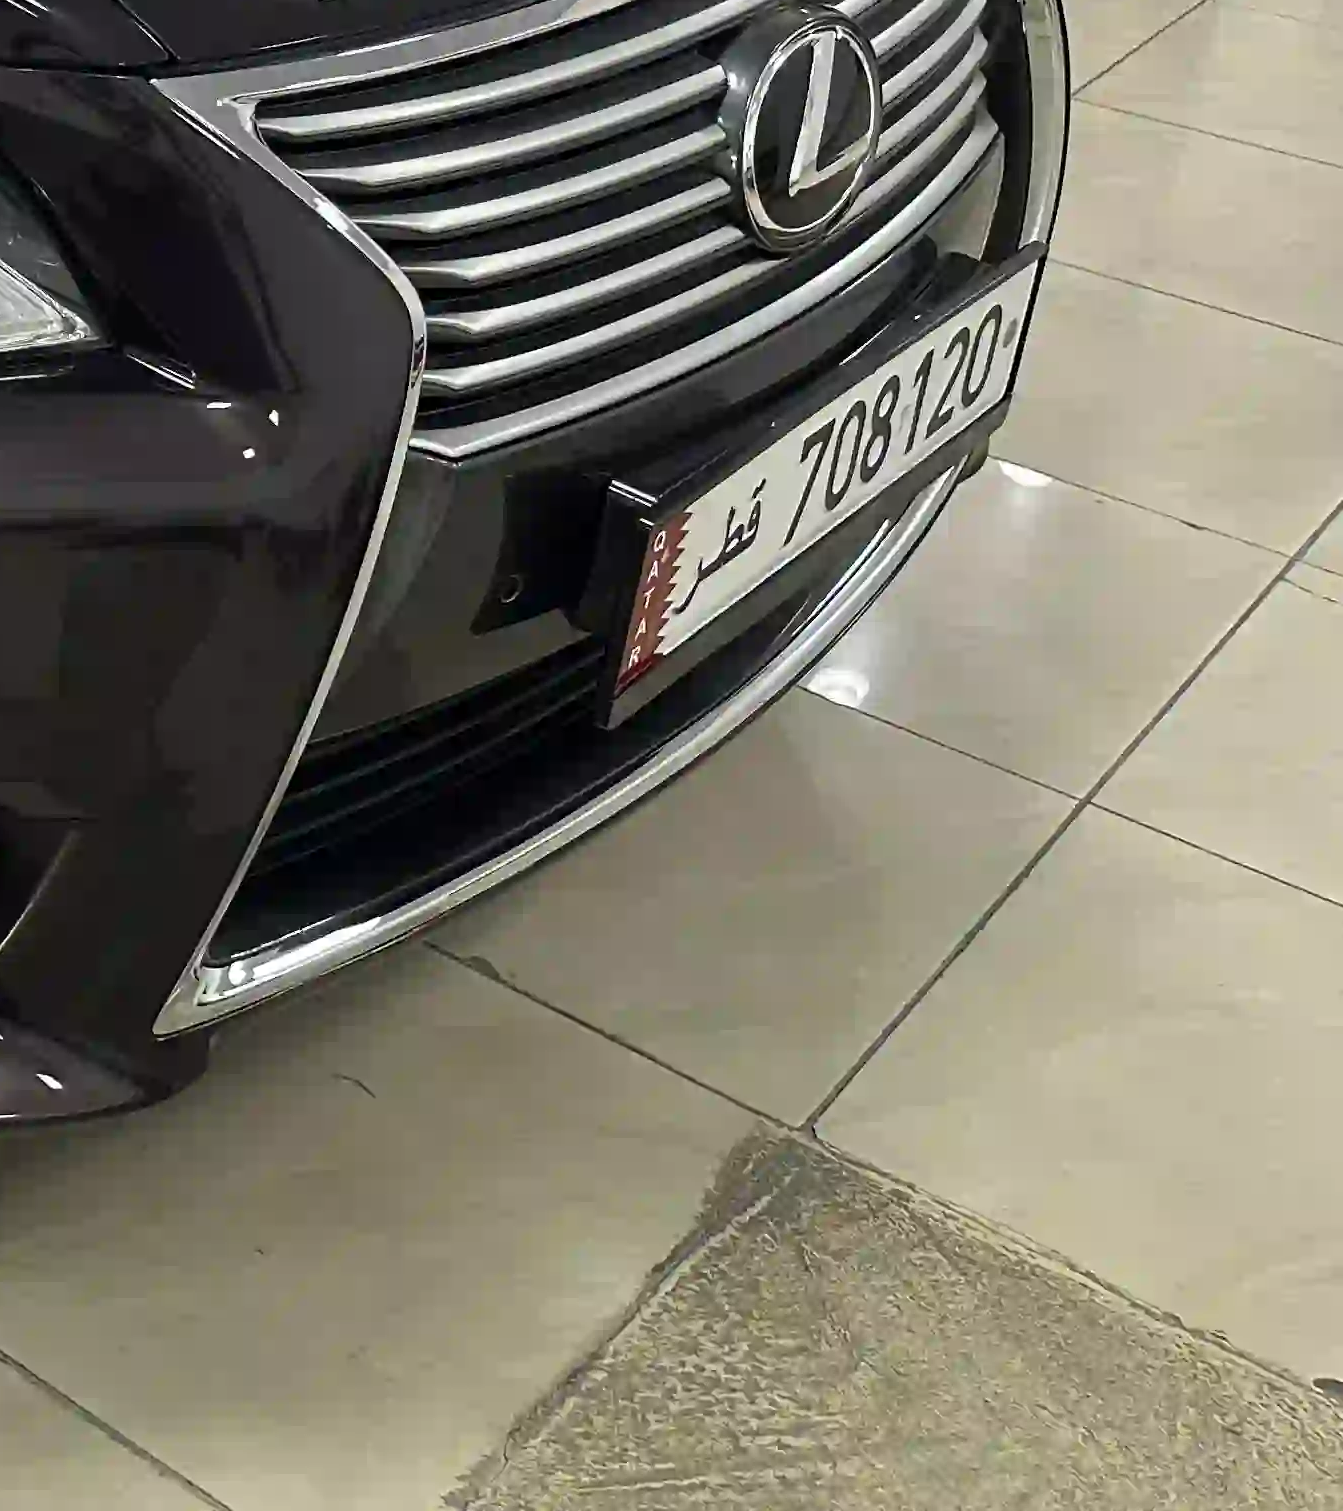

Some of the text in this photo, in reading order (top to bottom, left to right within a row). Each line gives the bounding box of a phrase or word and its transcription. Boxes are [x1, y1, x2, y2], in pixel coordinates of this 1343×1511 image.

[782, 304, 1003, 548] 708120
[628, 530, 667, 668] QATAR
[672, 478, 767, 615] قطر
